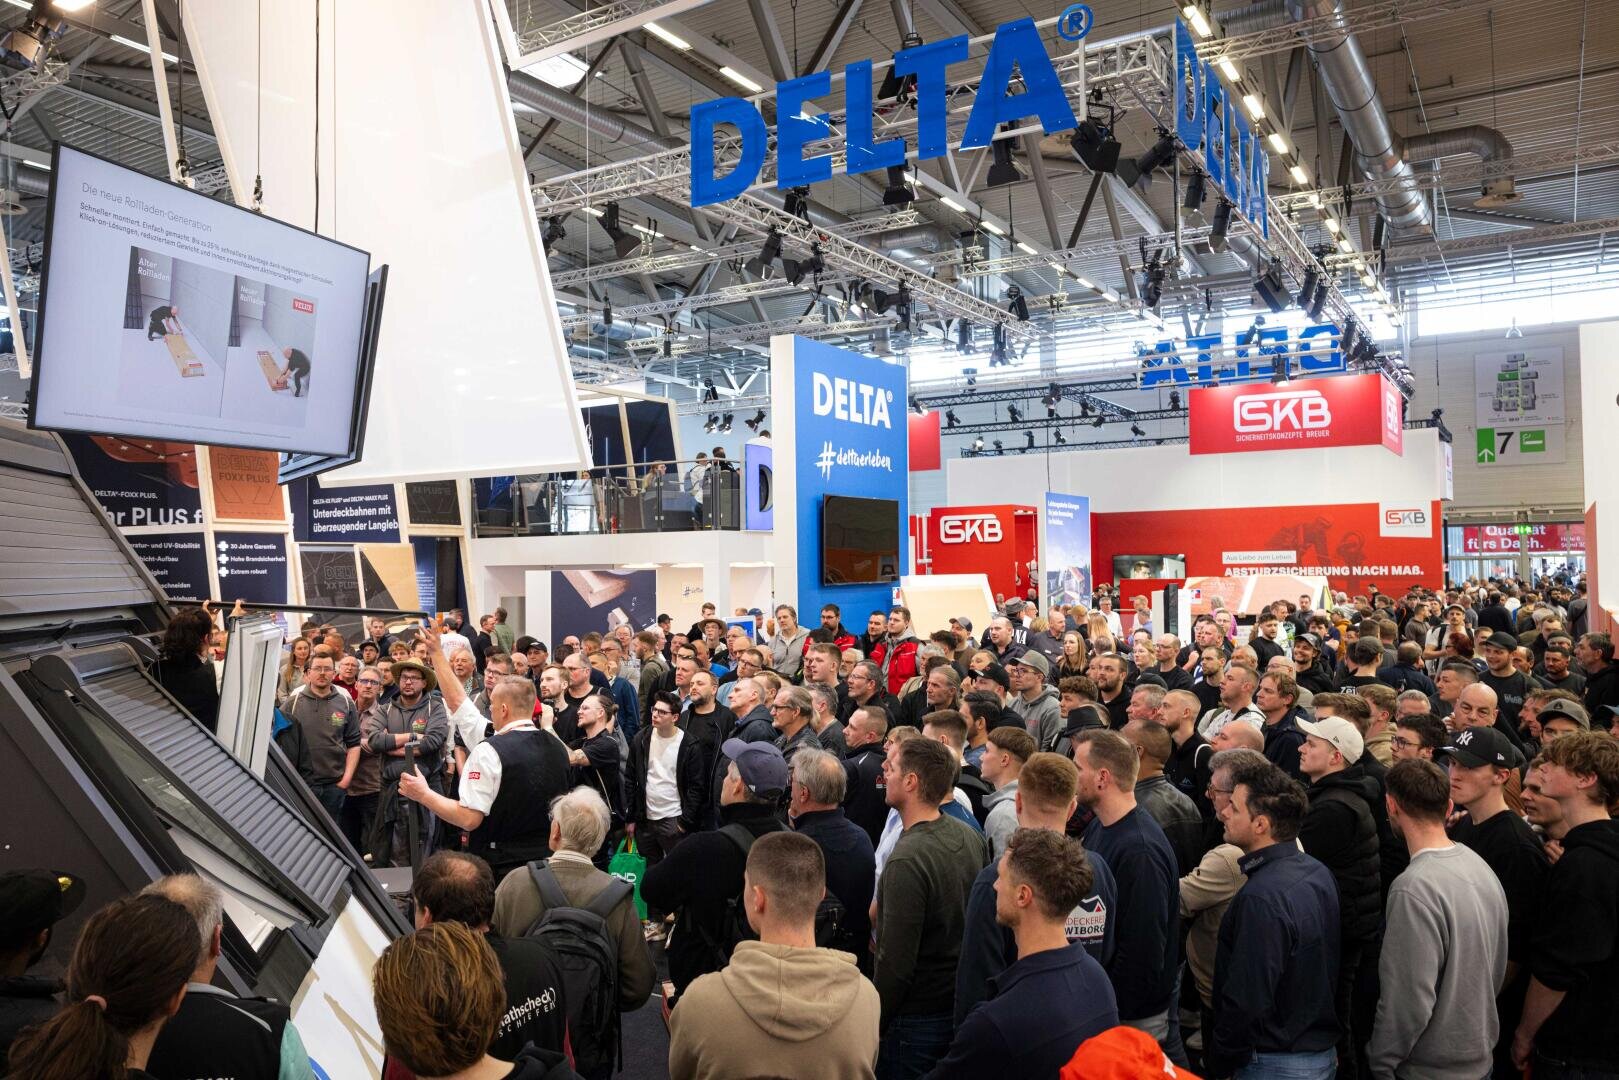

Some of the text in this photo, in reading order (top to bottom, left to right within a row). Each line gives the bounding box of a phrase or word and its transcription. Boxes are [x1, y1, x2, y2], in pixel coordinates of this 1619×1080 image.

[82, 182, 98, 196] Die
[100, 189, 123, 204] neue
[80, 202, 111, 218] Schneller
[142, 221, 165, 234] Einfach
[138, 257, 158, 268] Alter
[1233, 389, 1332, 432] SKB
[1235, 429, 1330, 442] SICHERHEITSKONZEPTE BREUER
[1496, 431, 1514, 455] 7
[814, 440, 893, 483] #deltaerleben
[219, 472, 271, 484] FOXX PLUS
[132, 507, 188, 525] PLUS
[313, 504, 391, 519] Unterdeckbahnen mit
[1385, 509, 1426, 525] SKB
[313, 518, 399, 533] überzeugender Langleb
[940, 513, 1002, 543] SKB
[1500, 537, 1544, 549] Dah.
[1224, 566, 1350, 577] ABSTURZSICHERUNG
[1352, 565, 1388, 576] NACH
[1455, 730, 1473, 746] NY
